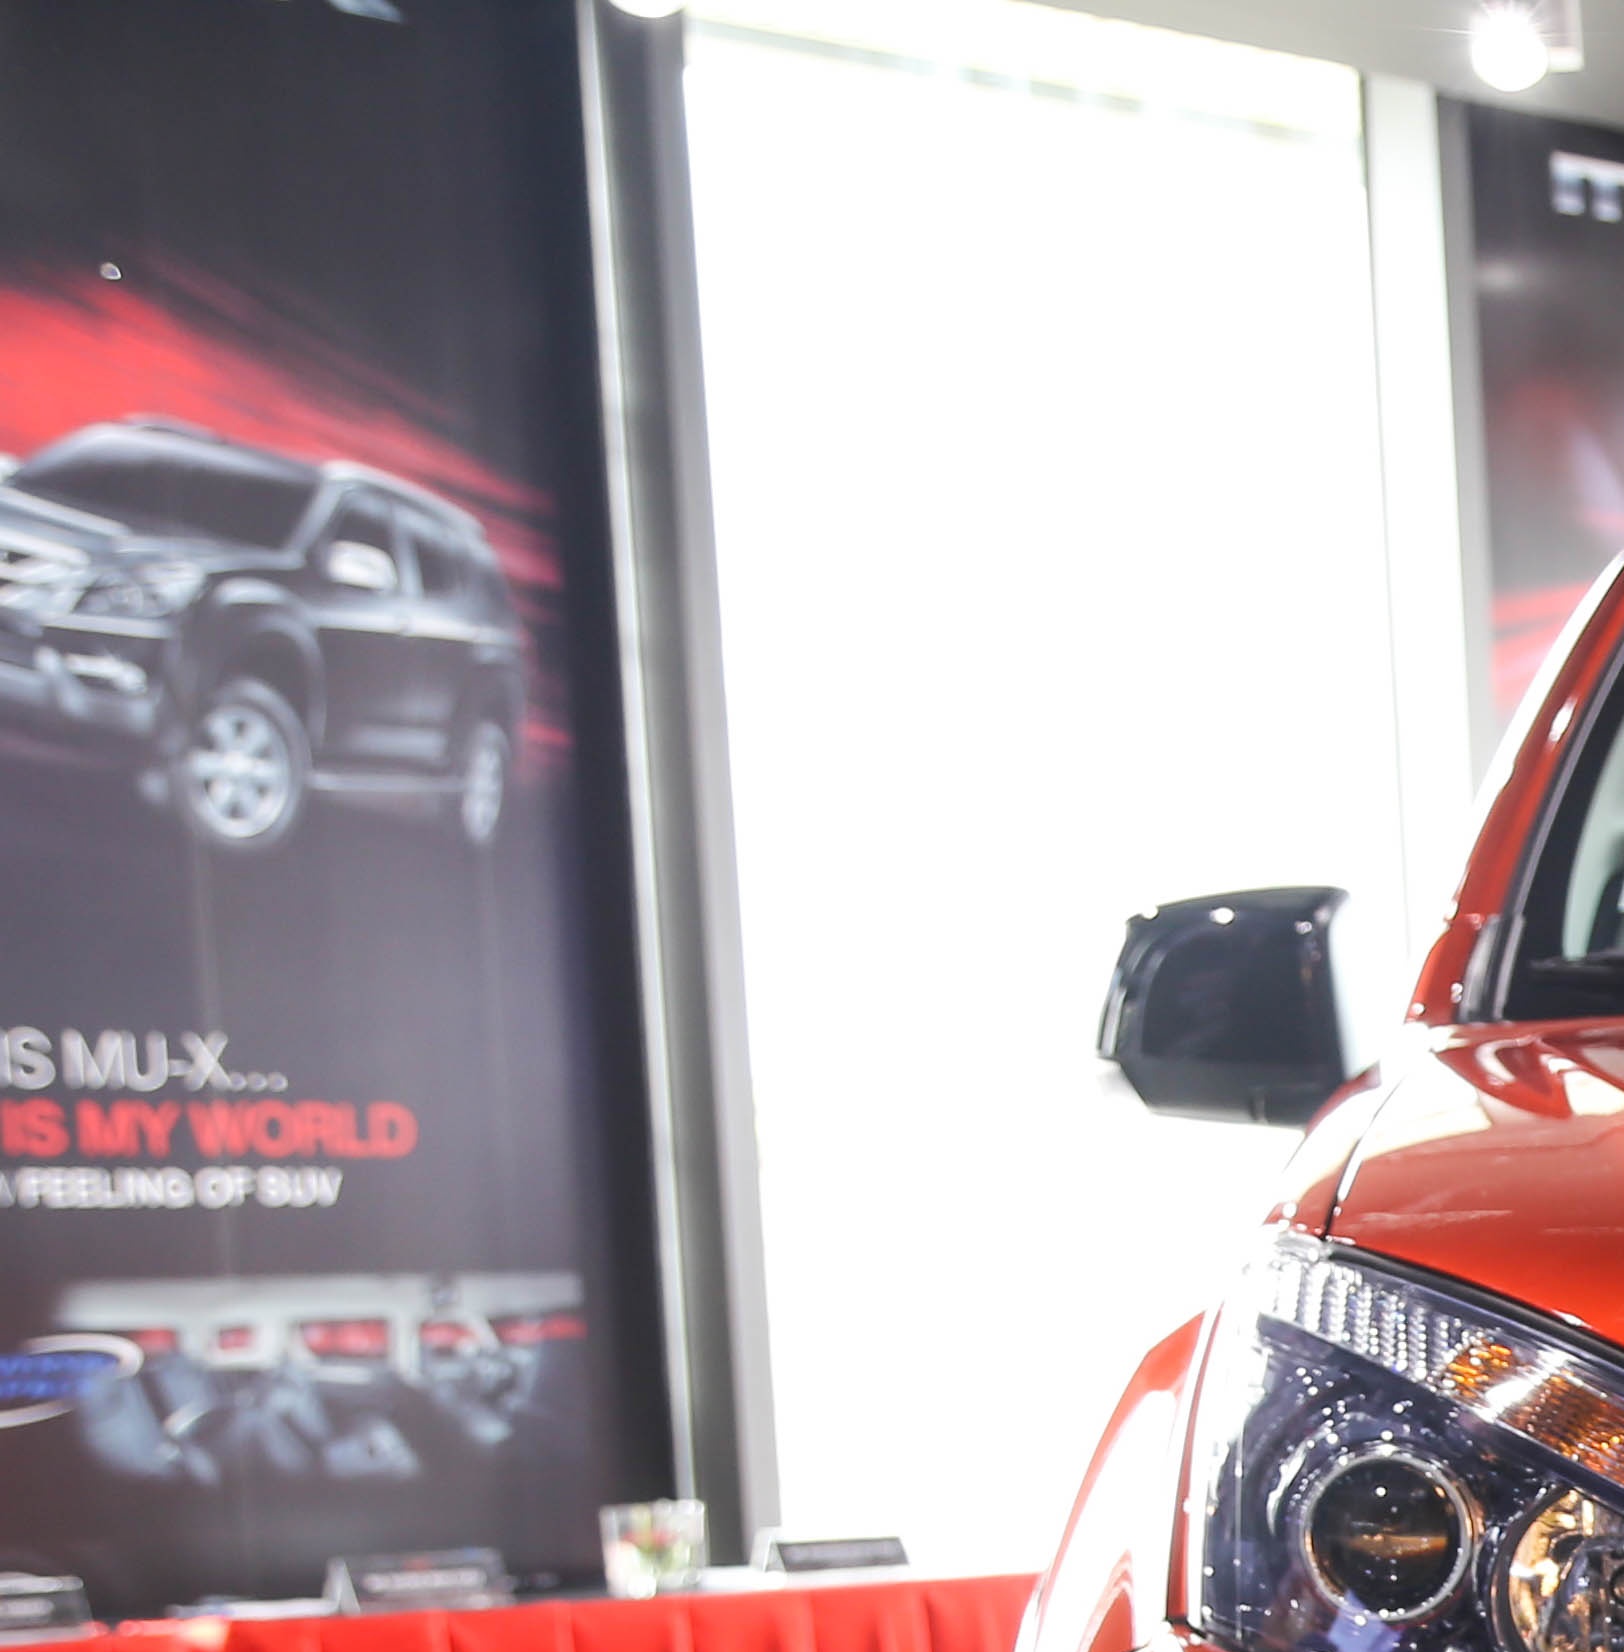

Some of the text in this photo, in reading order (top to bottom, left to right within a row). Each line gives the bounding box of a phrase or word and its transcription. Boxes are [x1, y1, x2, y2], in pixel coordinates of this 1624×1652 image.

[2, 1098, 418, 1158] IS MY WORLD
[16, 1166, 193, 1209] FEELING
[194, 1166, 257, 1208] OF
[256, 1166, 343, 1208] SUV
